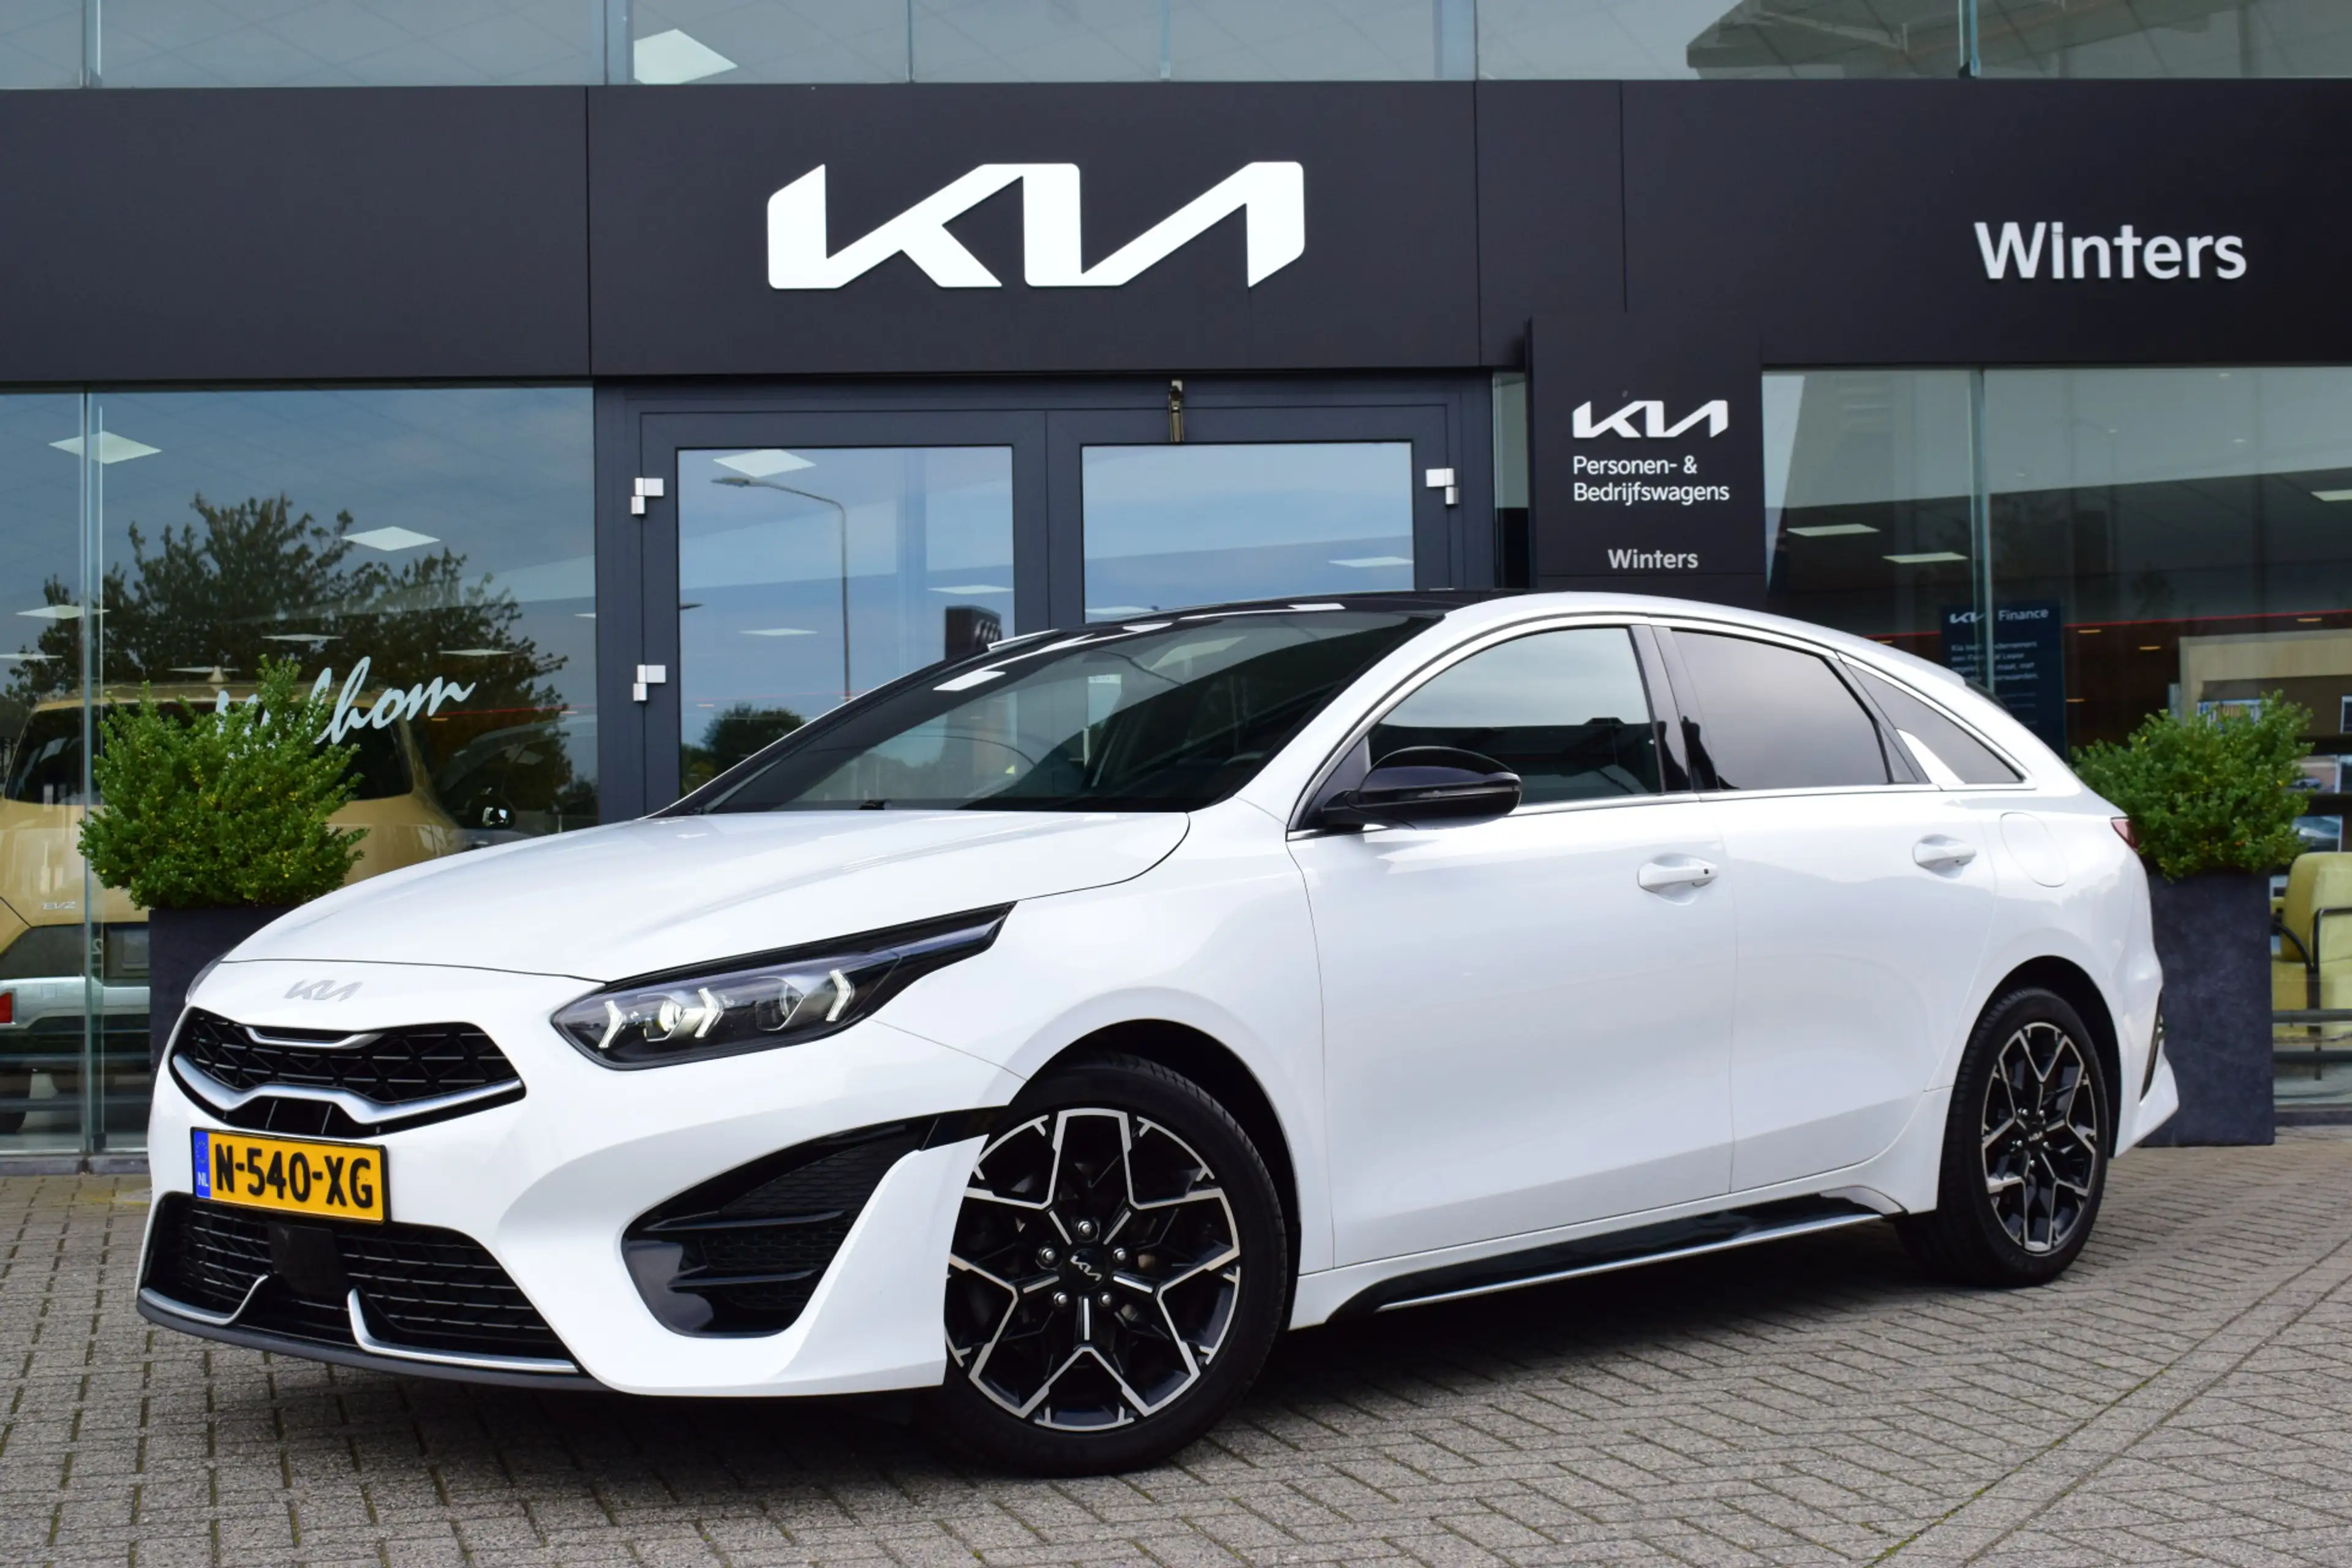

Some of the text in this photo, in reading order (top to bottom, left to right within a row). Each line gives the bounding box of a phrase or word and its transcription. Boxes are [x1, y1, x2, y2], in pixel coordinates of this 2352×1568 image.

[767, 161, 1306, 290] KIA
[1974, 222, 2247, 280] Winters
[1572, 399, 1729, 439] KIA
[1573, 455, 1698, 475] Personen- &
[1574, 481, 1730, 507] Bedrijfswagens
[1607, 548, 1699, 570] Winters
[1997, 609, 2049, 621] Finance
[283, 979, 364, 1002] KIA
[197, 1171, 209, 1188] NL
[215, 1143, 374, 1209] N-540-XG
